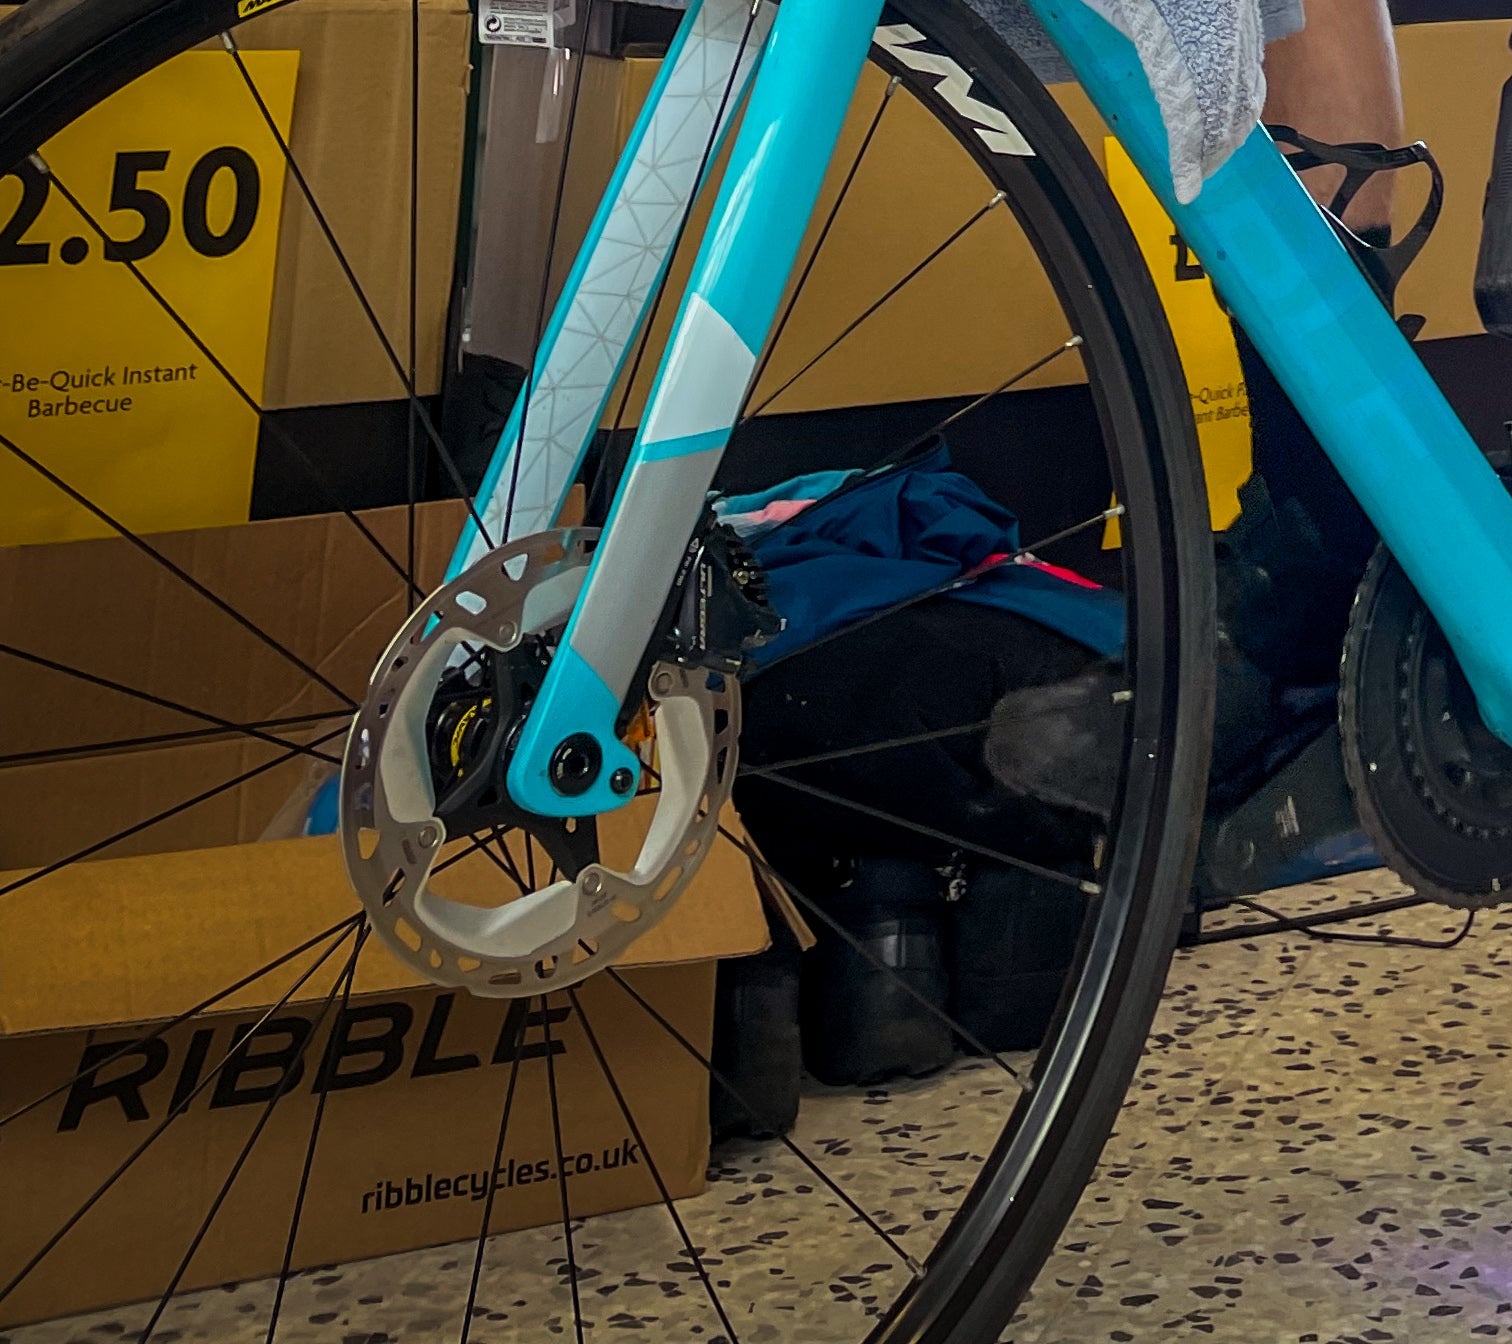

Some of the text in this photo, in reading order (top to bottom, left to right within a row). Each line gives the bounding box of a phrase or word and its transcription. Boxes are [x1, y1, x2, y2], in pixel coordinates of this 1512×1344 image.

[0, 363, 198, 393] -Be-Quick Instant
[27, 396, 134, 418] Barbecue
[56, 993, 573, 1134] RIBBLE
[360, 1138, 640, 1214] ribblecycles.co.uk
